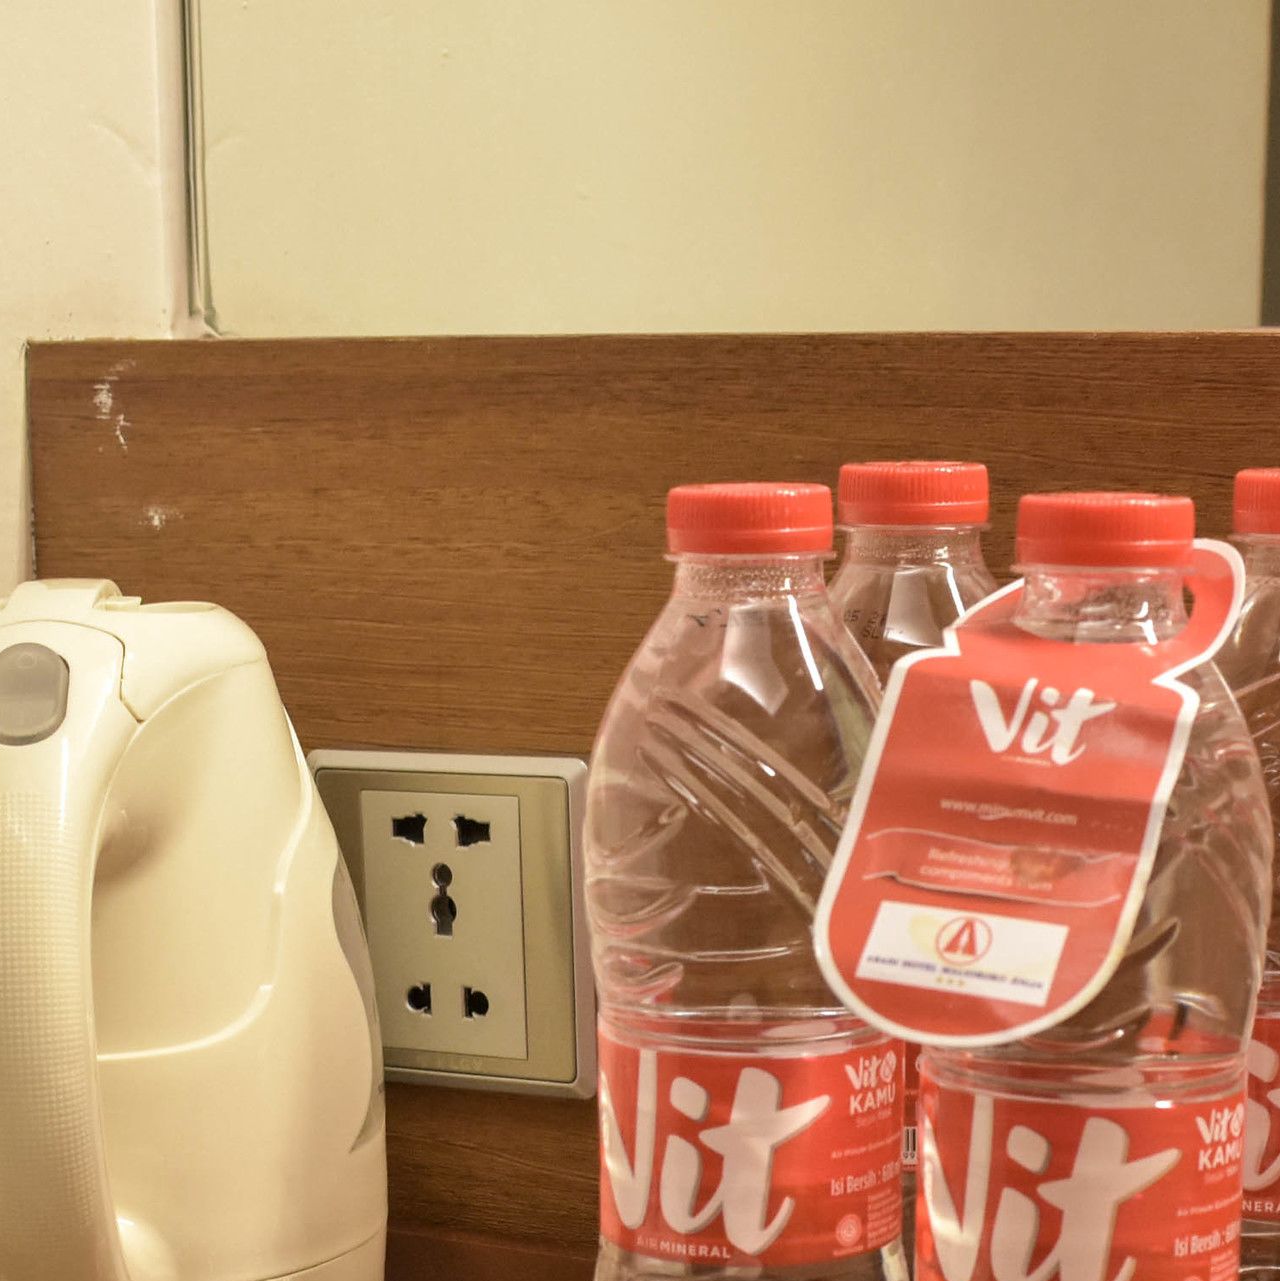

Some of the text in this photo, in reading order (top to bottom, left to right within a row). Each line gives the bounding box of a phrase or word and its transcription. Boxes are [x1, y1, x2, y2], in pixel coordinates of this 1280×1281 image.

[969, 677, 1116, 766] Vit
[849, 1081, 895, 1116] KAMU
[600, 1050, 832, 1255] Vit
[659, 1240, 732, 1259] MINERAL
